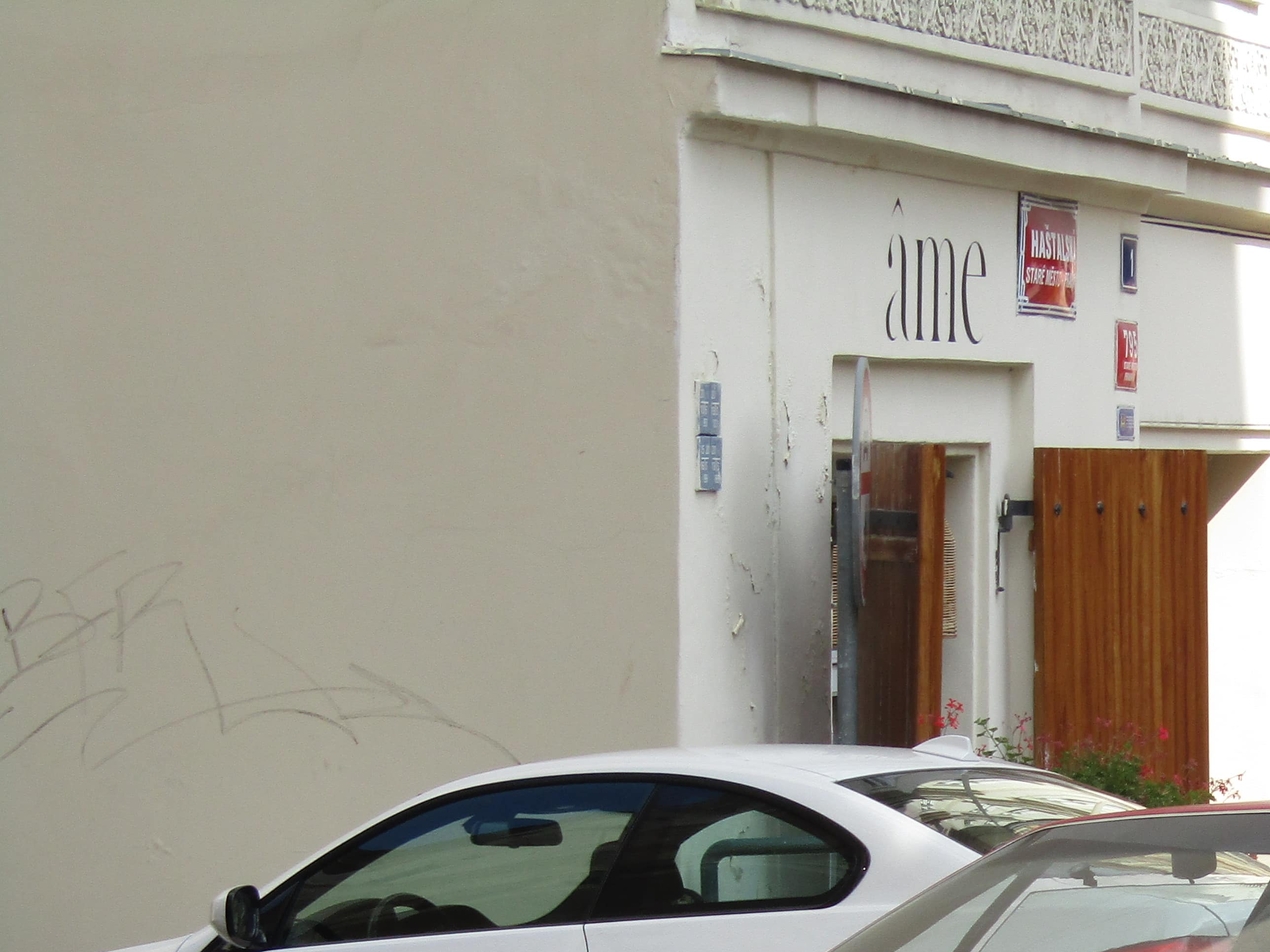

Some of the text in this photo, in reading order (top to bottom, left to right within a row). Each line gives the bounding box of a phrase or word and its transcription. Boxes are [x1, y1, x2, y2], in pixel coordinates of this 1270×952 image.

[885, 197, 987, 345] âme
[1025, 264, 1046, 285] STARÉ
[1129, 248, 1134, 278] 1
[1122, 328, 1138, 359] 795
